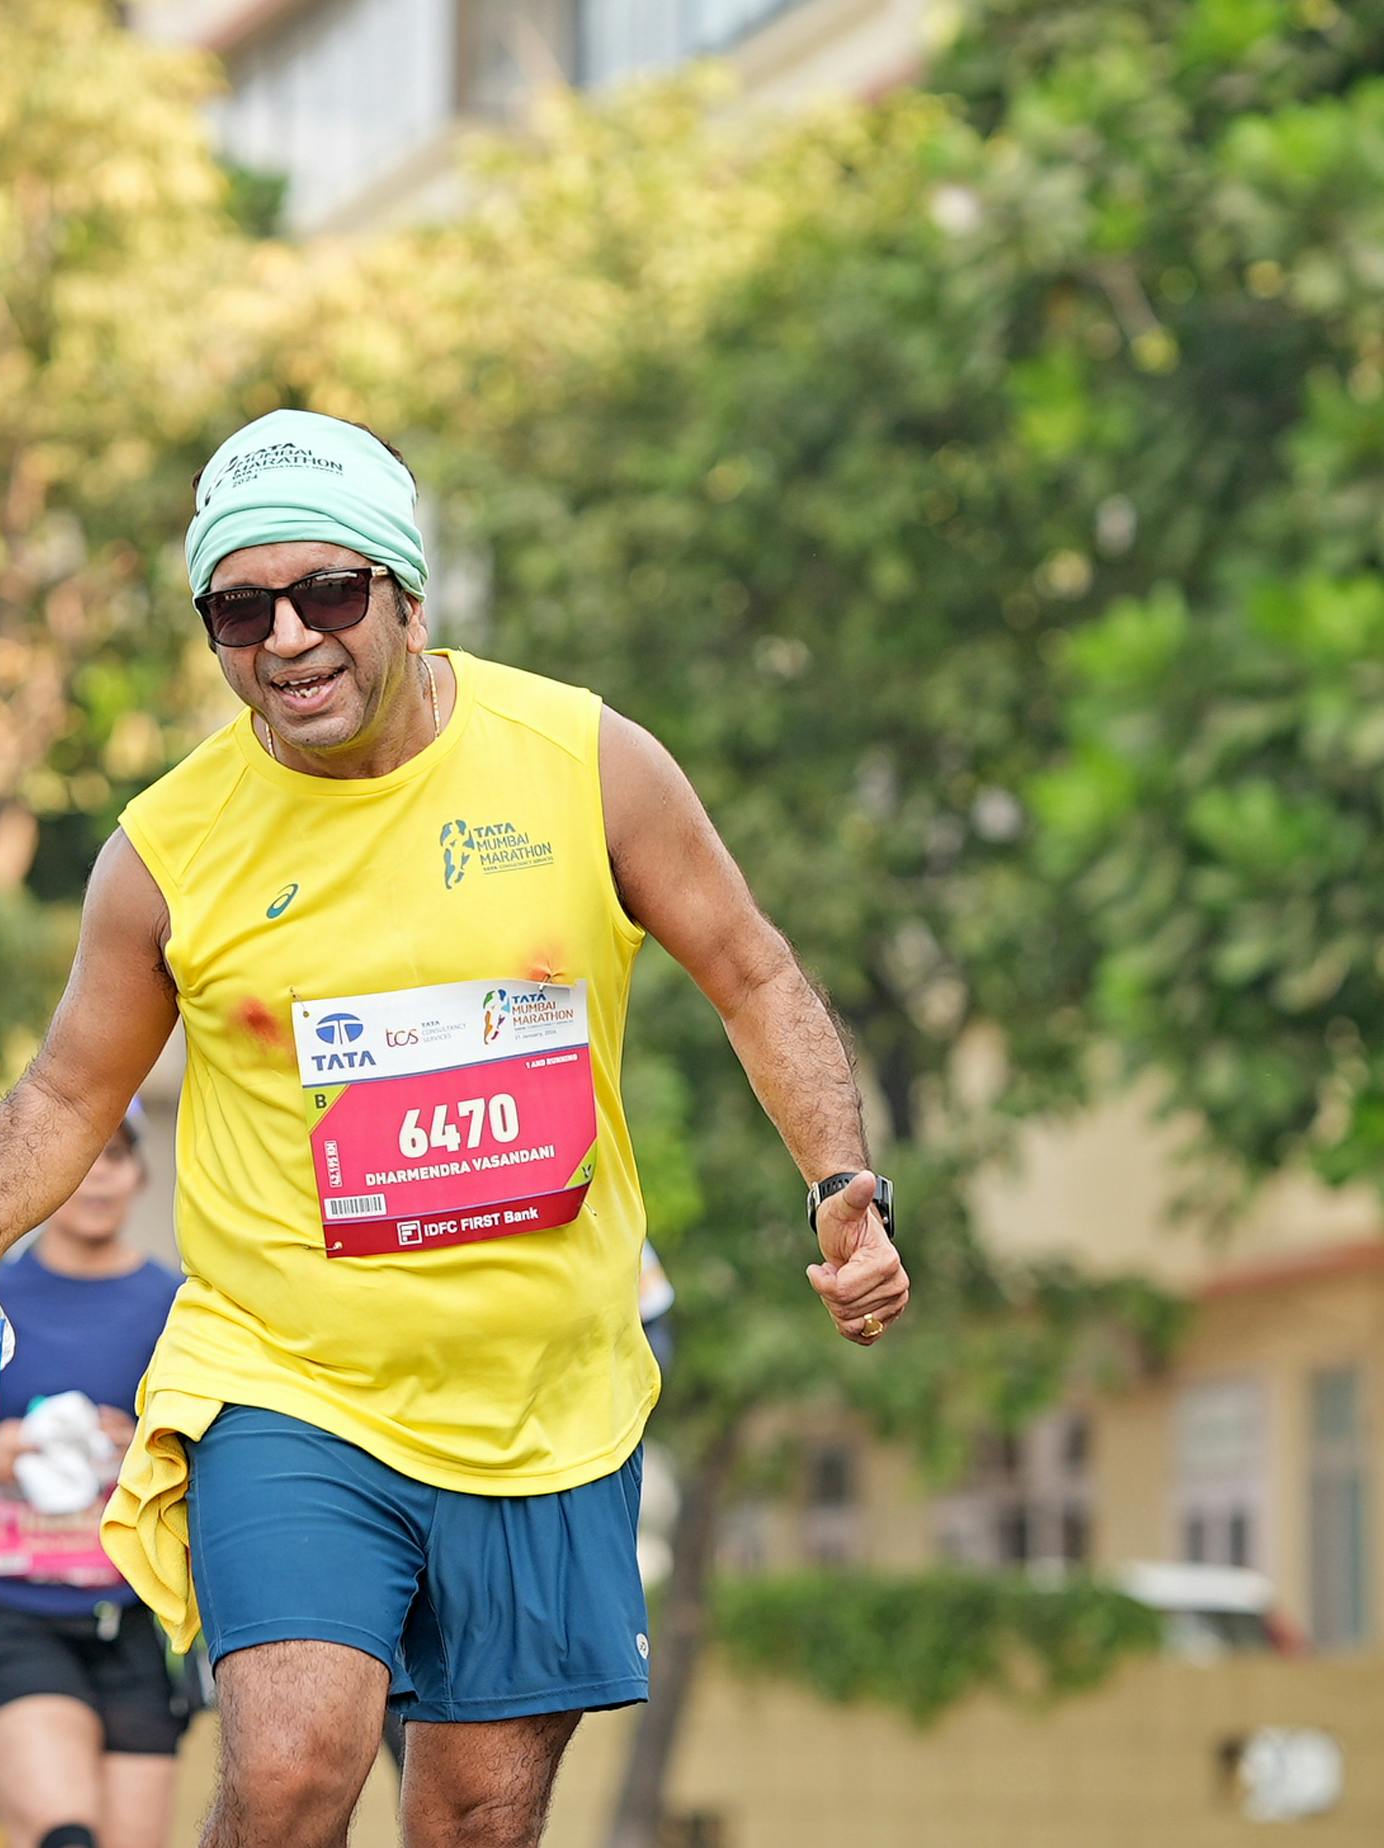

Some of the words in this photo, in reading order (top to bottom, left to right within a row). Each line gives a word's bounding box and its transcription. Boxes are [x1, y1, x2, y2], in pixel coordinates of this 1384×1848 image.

[234, 457, 343, 476] MARATHON
[473, 822, 516, 838] TATA
[476, 832, 530, 852] MUMBAI
[479, 842, 553, 866] MARATHON
[512, 993, 547, 1004] TATA
[512, 1001, 558, 1015] MUMBAI
[421, 1020, 440, 1028] TATA
[513, 1009, 574, 1027] MARATHON
[385, 1028, 419, 1048] tcs
[311, 1050, 377, 1071] TATA
[314, 1093, 328, 1109] B
[399, 1093, 520, 1158] 6470
[366, 1161, 471, 1187] DHARMENDRA
[471, 1145, 555, 1171] VASANDANI
[424, 1219, 457, 1237] IDFC
[460, 1212, 501, 1231] FIRST
[503, 1206, 539, 1224] Bank
